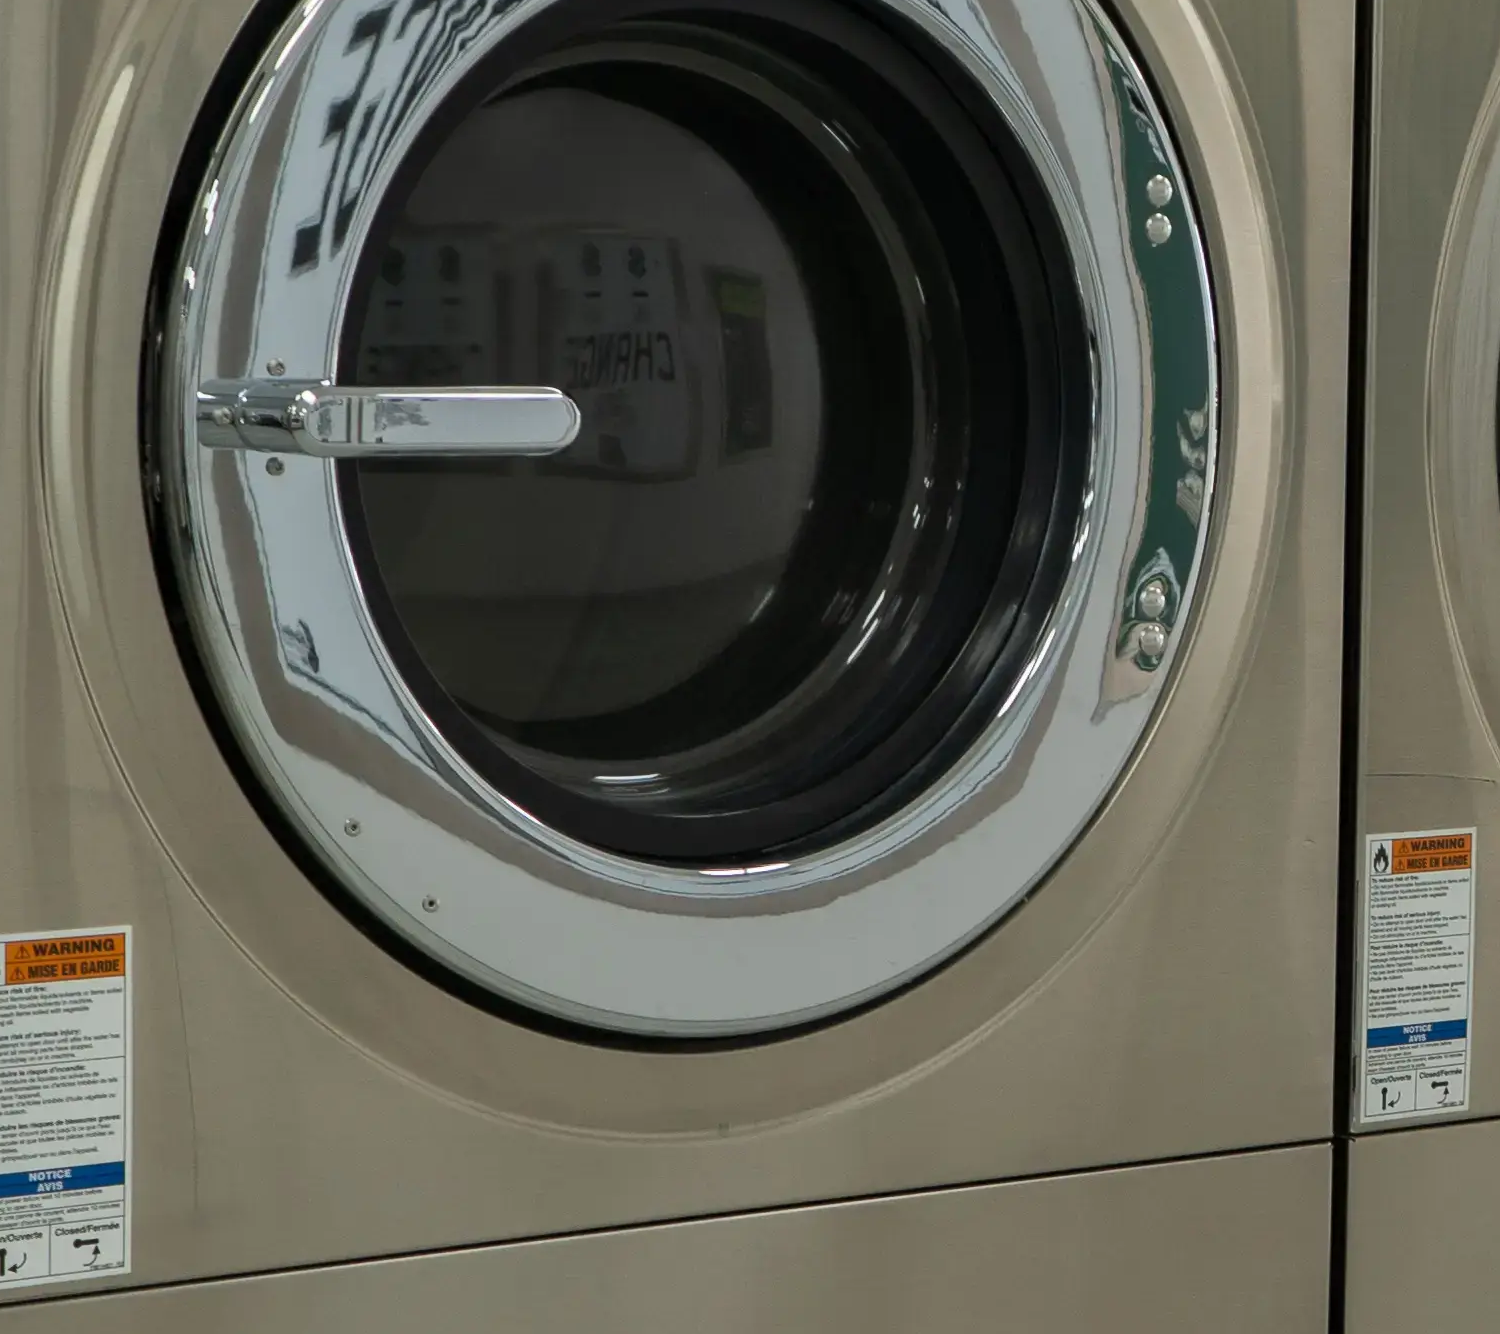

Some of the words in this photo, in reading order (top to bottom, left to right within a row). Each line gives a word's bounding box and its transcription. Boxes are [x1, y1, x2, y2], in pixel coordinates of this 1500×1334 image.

[1410, 837, 1464, 851] WARNING
[32, 938, 115, 957] WARNING
[27, 963, 58, 978] MISE
[61, 961, 76, 976] EN
[80, 958, 120, 974] GARDE
[1403, 1024, 1433, 1034] NOTICE
[1408, 1034, 1427, 1043] AVIS
[28, 1168, 71, 1182] NOTICE
[37, 1181, 62, 1192] AVIS
[54, 1220, 119, 1236] Closed/Fermée
